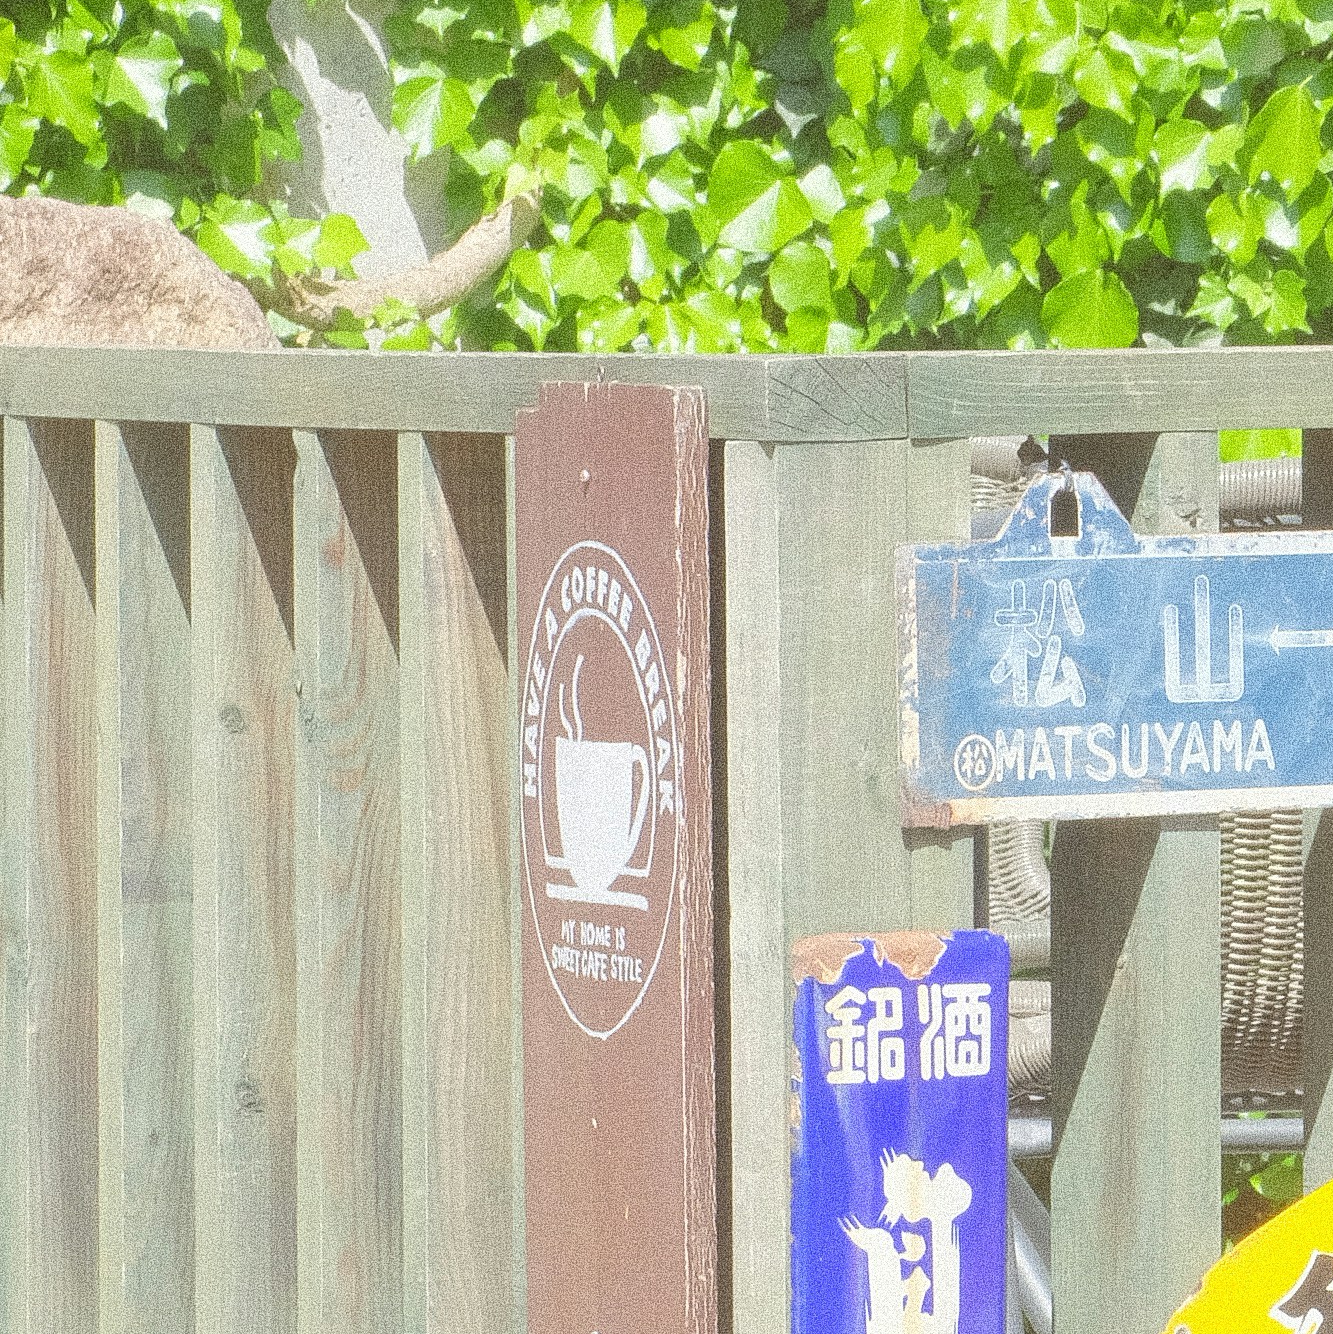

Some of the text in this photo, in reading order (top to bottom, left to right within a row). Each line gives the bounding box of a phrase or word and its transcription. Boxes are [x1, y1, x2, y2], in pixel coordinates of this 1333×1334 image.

[990, 574, 1246, 709] 松山
[523, 565, 675, 816] HAVE A COFFEE BREAK
[995, 720, 1275, 783] MATSUYAMA
[560, 918, 627, 951] MY HOME IS
[581, 949, 608, 982] CAFE
[610, 953, 644, 984] STYLE
[824, 982, 993, 1085] 銘酒
